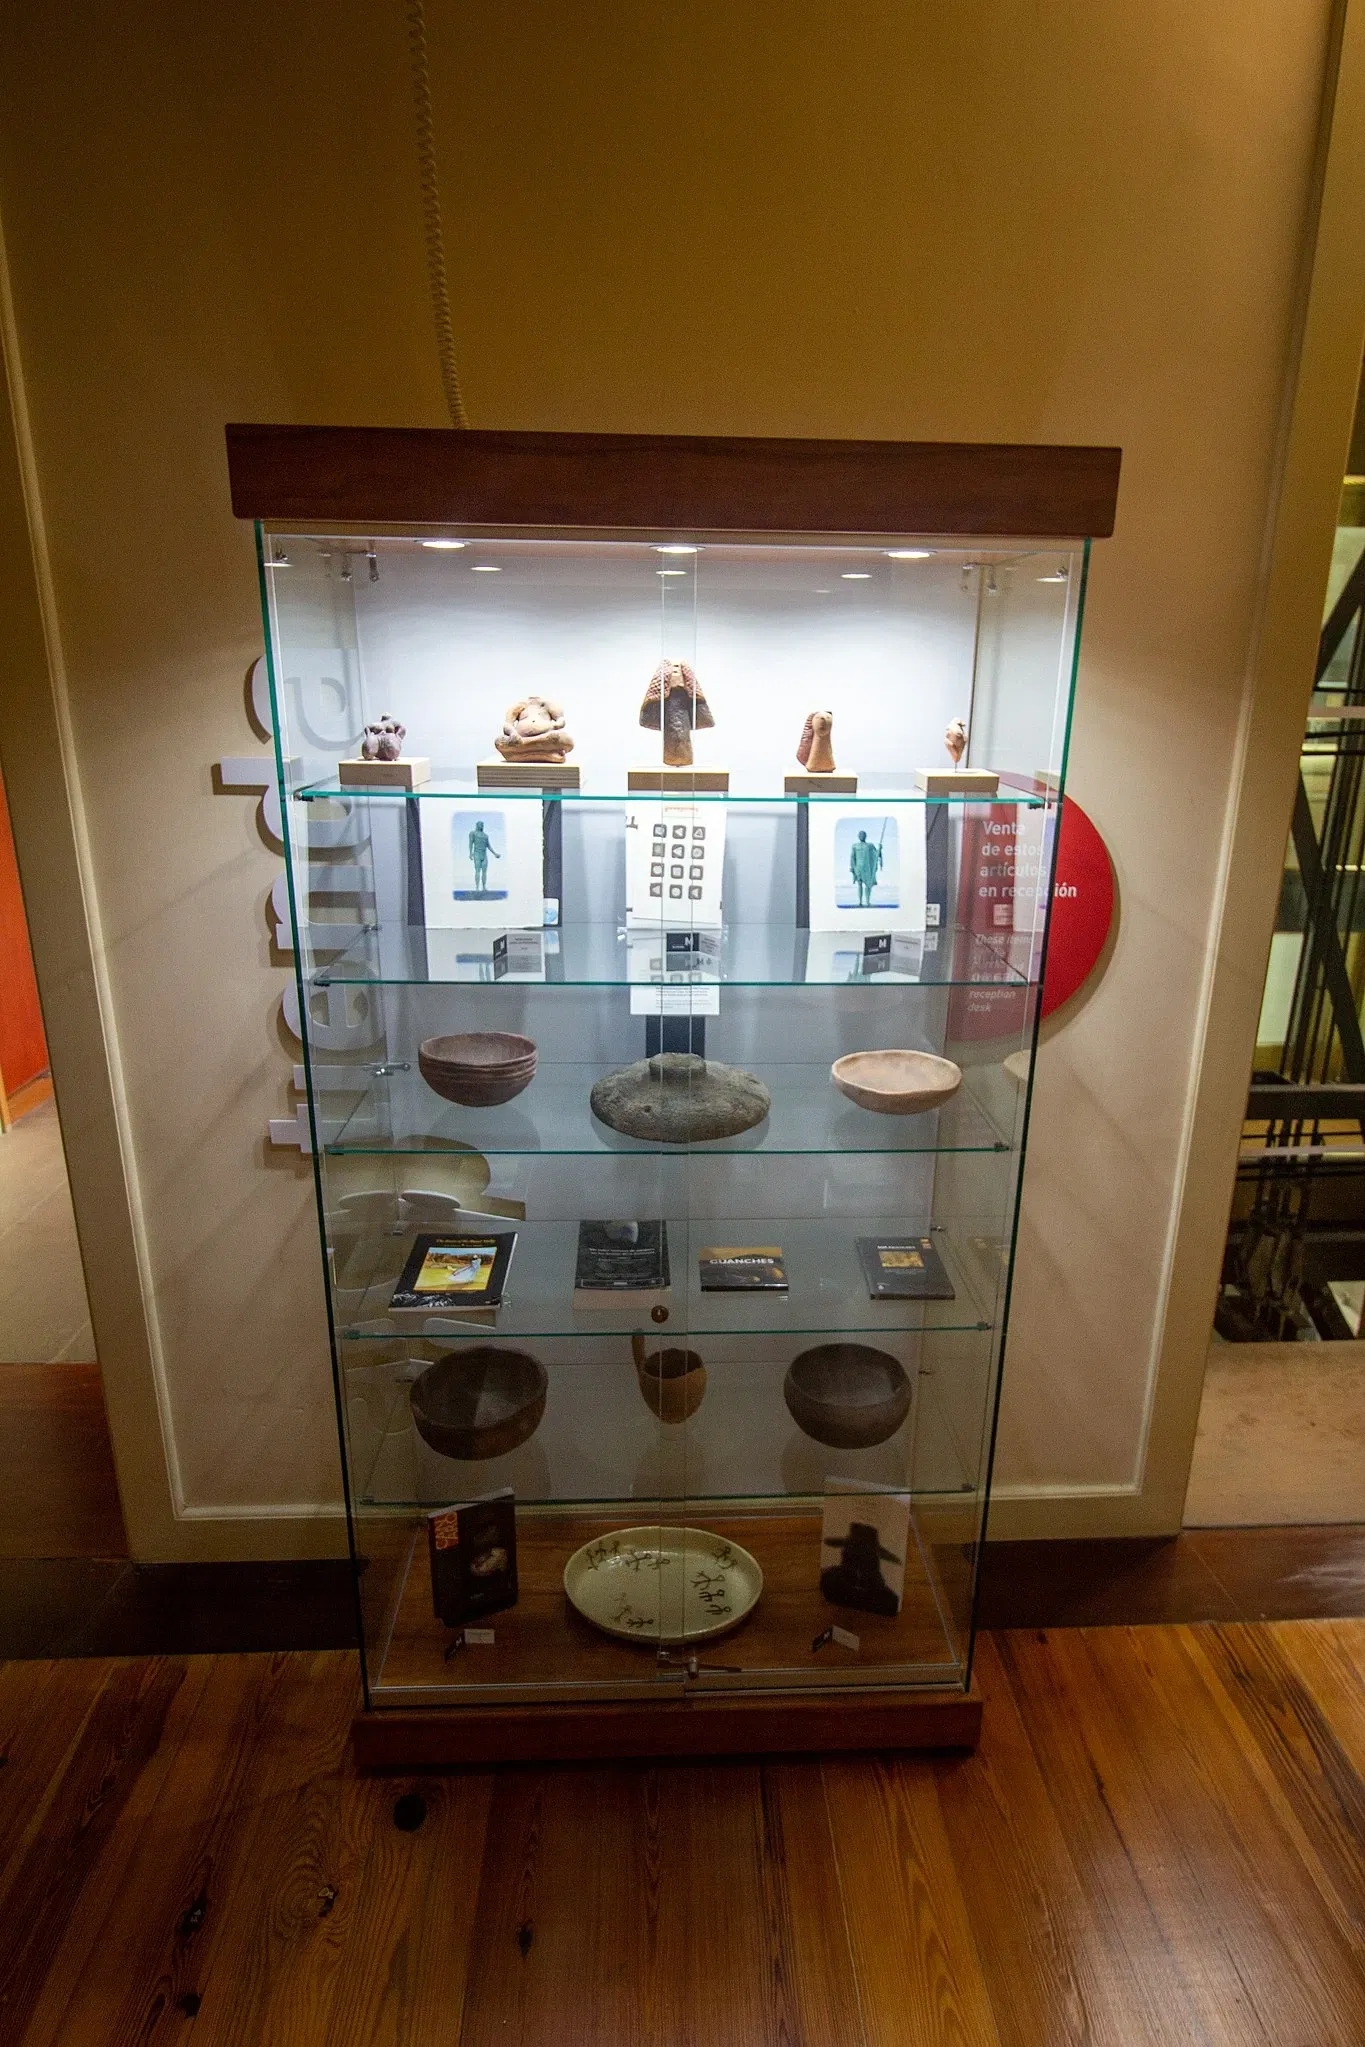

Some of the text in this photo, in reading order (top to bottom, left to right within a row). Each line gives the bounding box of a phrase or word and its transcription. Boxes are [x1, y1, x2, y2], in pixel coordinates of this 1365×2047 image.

[983, 821, 1025, 835] Venta
[981, 842, 1044, 856] de estos
[980, 861, 1046, 877] artículos
[978, 886, 997, 897] en
[969, 989, 1016, 1000] reception
[967, 1003, 991, 1012] desk
